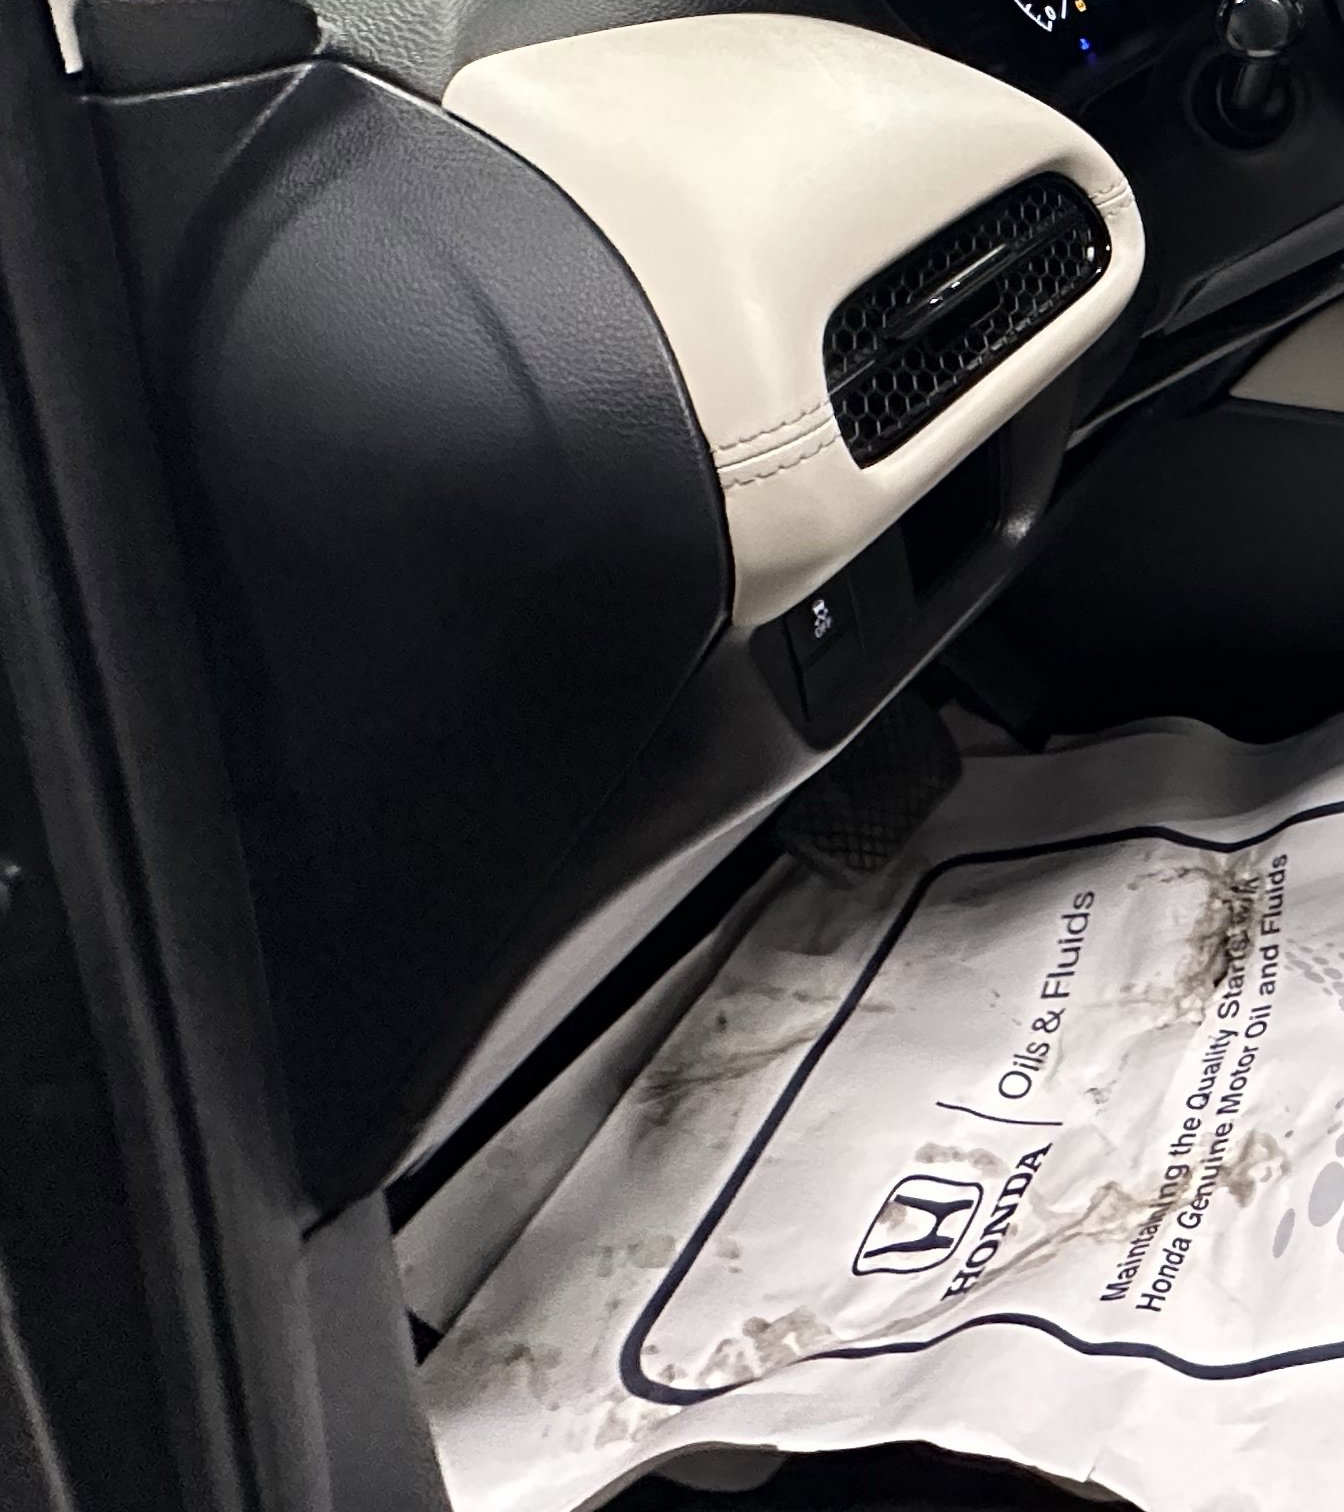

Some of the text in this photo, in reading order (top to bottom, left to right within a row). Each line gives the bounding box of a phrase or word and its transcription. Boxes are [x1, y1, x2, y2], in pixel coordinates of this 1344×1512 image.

[1044, 5, 1056, 20] 0
[998, 890, 1095, 1099] Oils & Fluids
[1135, 854, 1288, 1312] Honda Genuine Motor Oil and Fluids
[941, 1142, 1053, 1302] HONDA
[1100, 1163, 1190, 1302] Maintaining
[1169, 1117, 1201, 1157] the
[1186, 1027, 1240, 1111] Quality
